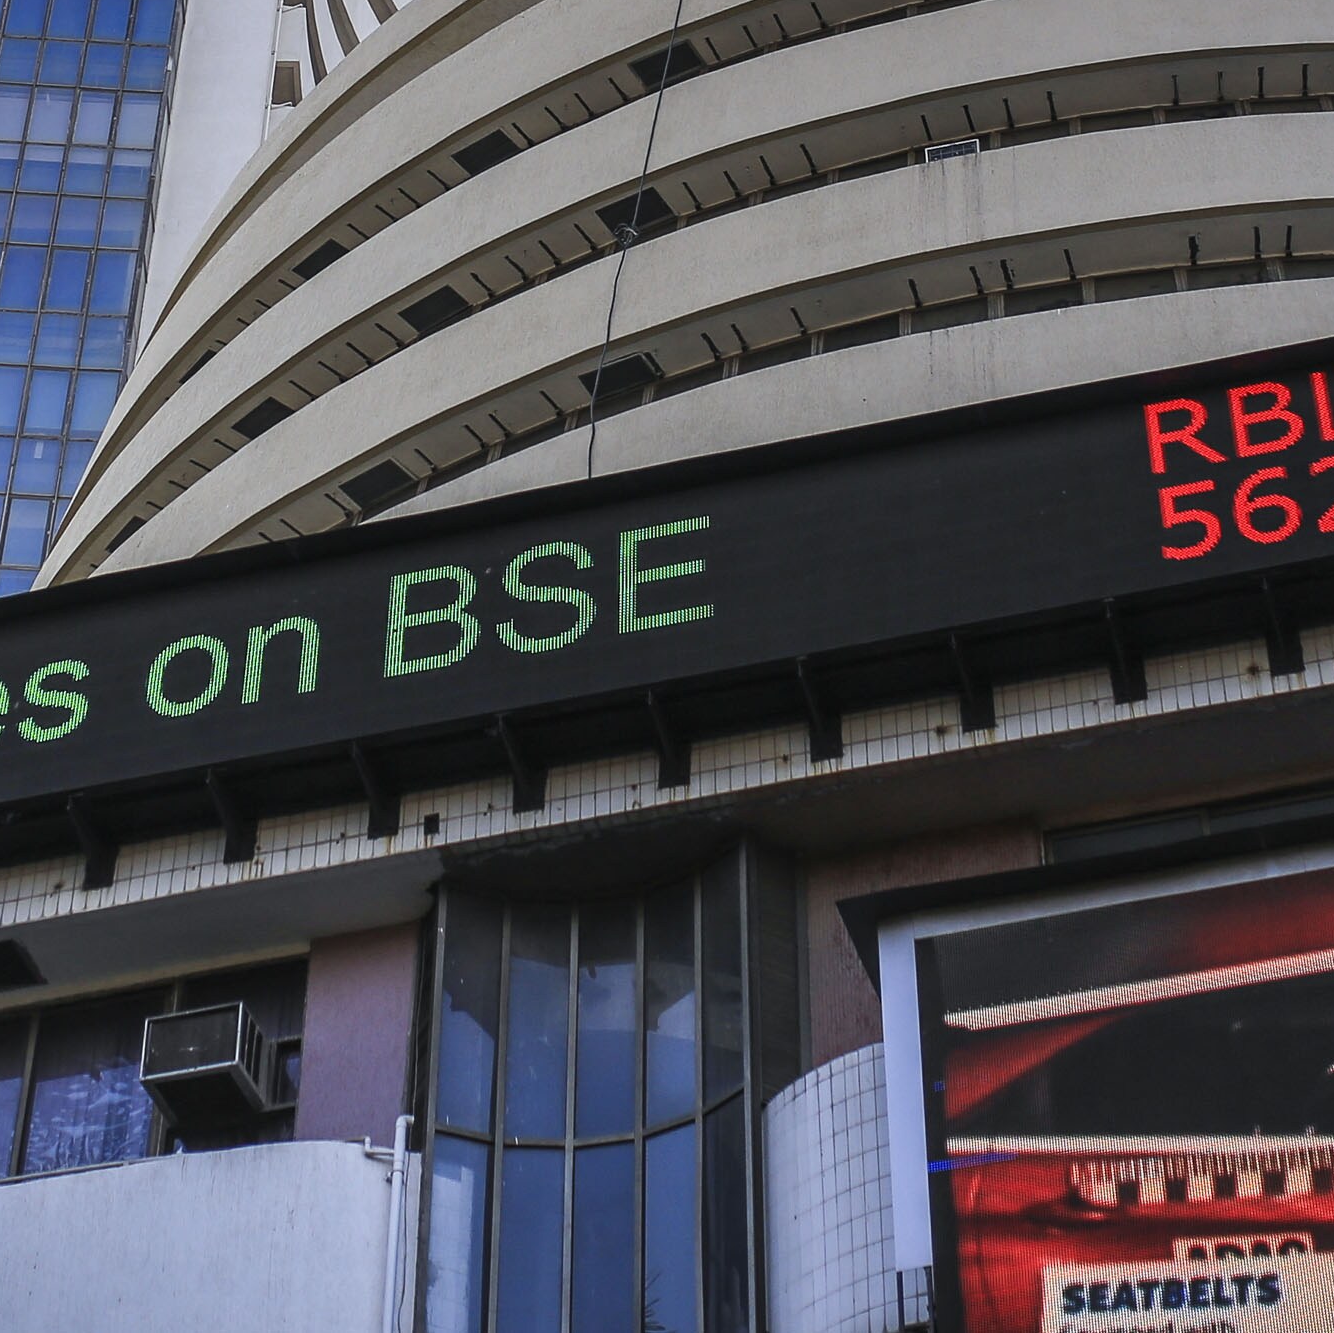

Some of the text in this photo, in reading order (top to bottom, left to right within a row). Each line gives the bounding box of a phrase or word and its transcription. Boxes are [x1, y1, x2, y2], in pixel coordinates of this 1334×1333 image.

[147, 615, 321, 718] on
[383, 514, 715, 679] BSE
[1061, 1273, 1283, 1316] SEATBELTS
